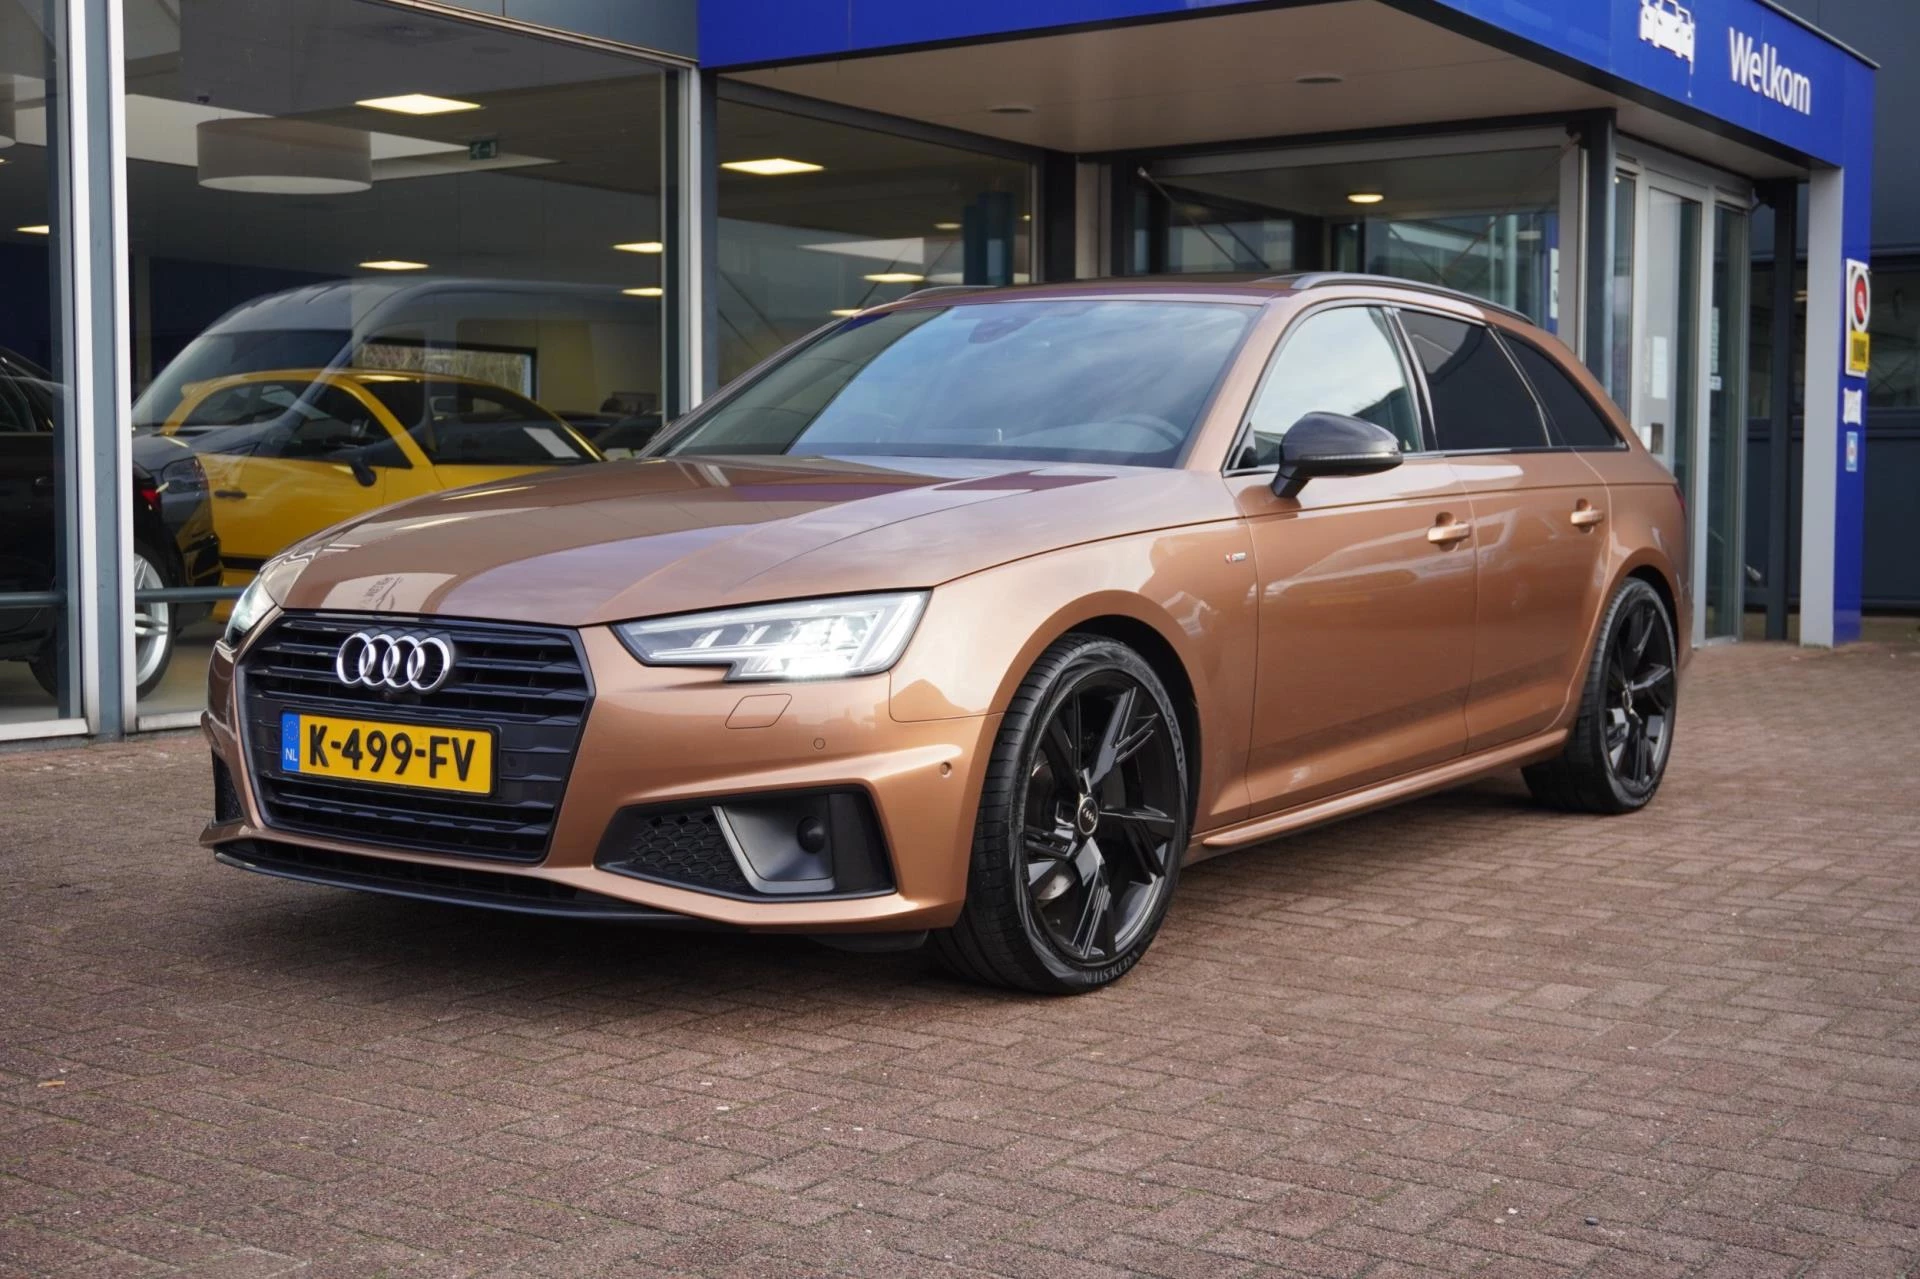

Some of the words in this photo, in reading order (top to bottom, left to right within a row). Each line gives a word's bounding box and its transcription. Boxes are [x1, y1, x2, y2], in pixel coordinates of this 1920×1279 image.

[1729, 27, 1811, 115] Welkom
[285, 748, 298, 762] NL
[309, 725, 476, 781] K-499-FV
